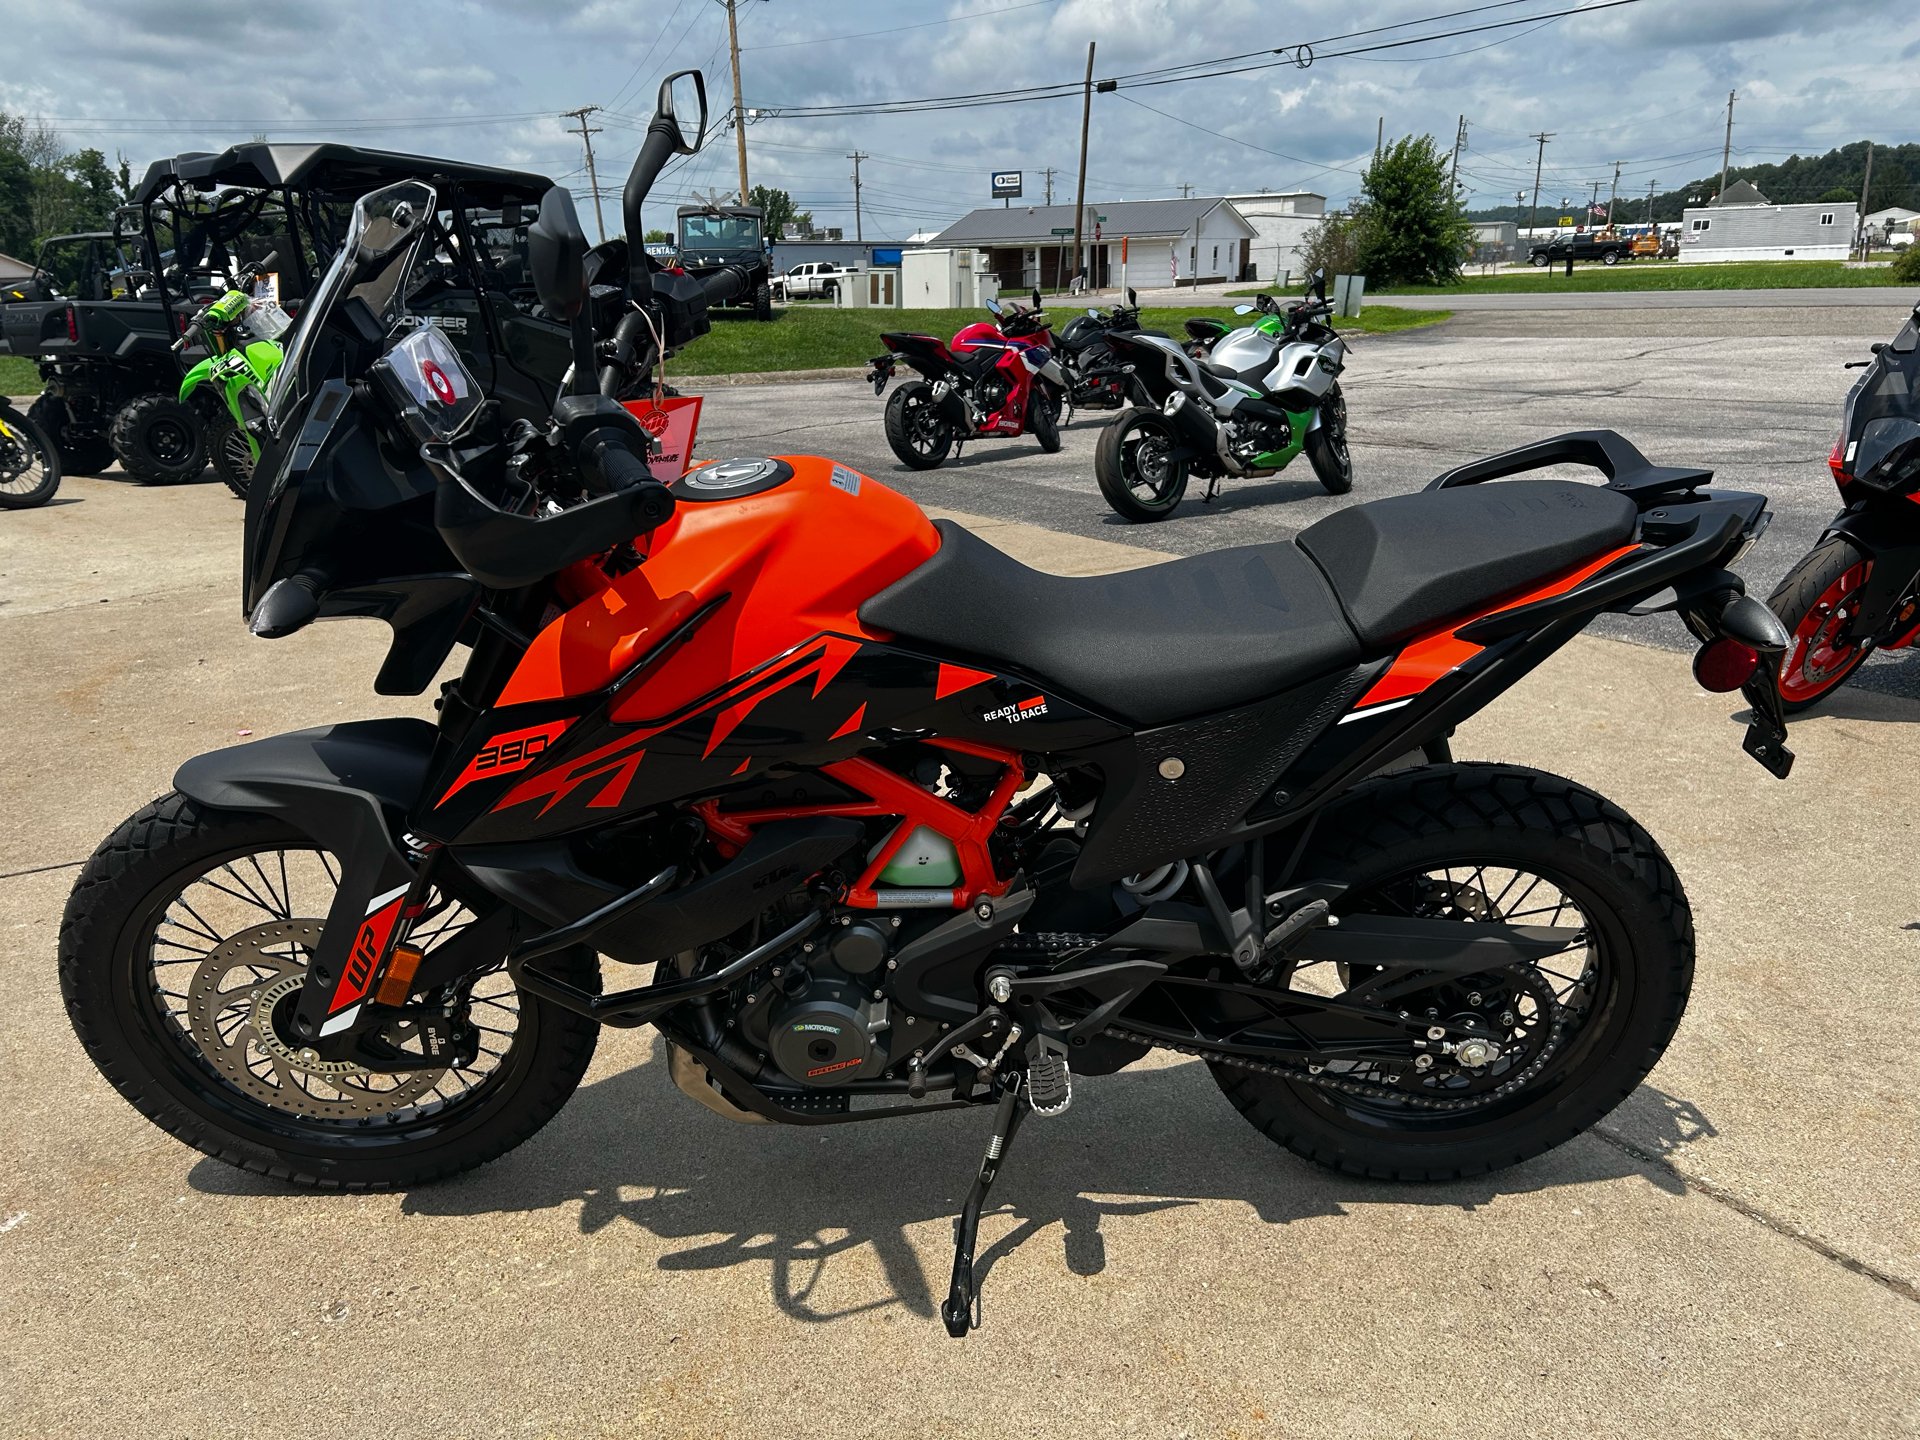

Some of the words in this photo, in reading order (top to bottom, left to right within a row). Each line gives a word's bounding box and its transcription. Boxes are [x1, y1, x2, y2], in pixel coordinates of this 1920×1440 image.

[646, 246, 675, 255] RENTAL
[998, 420, 1019, 429] HONDA
[646, 454, 680, 464] DVENTURE
[983, 704, 1016, 722] READY
[1006, 713, 1020, 724] TO
[1020, 704, 1049, 720] RACE
[476, 734, 549, 771] 390
[347, 924, 377, 994] WP
[804, 1024, 838, 1034] MOTOREX
[428, 1027, 440, 1055] BYBRE
